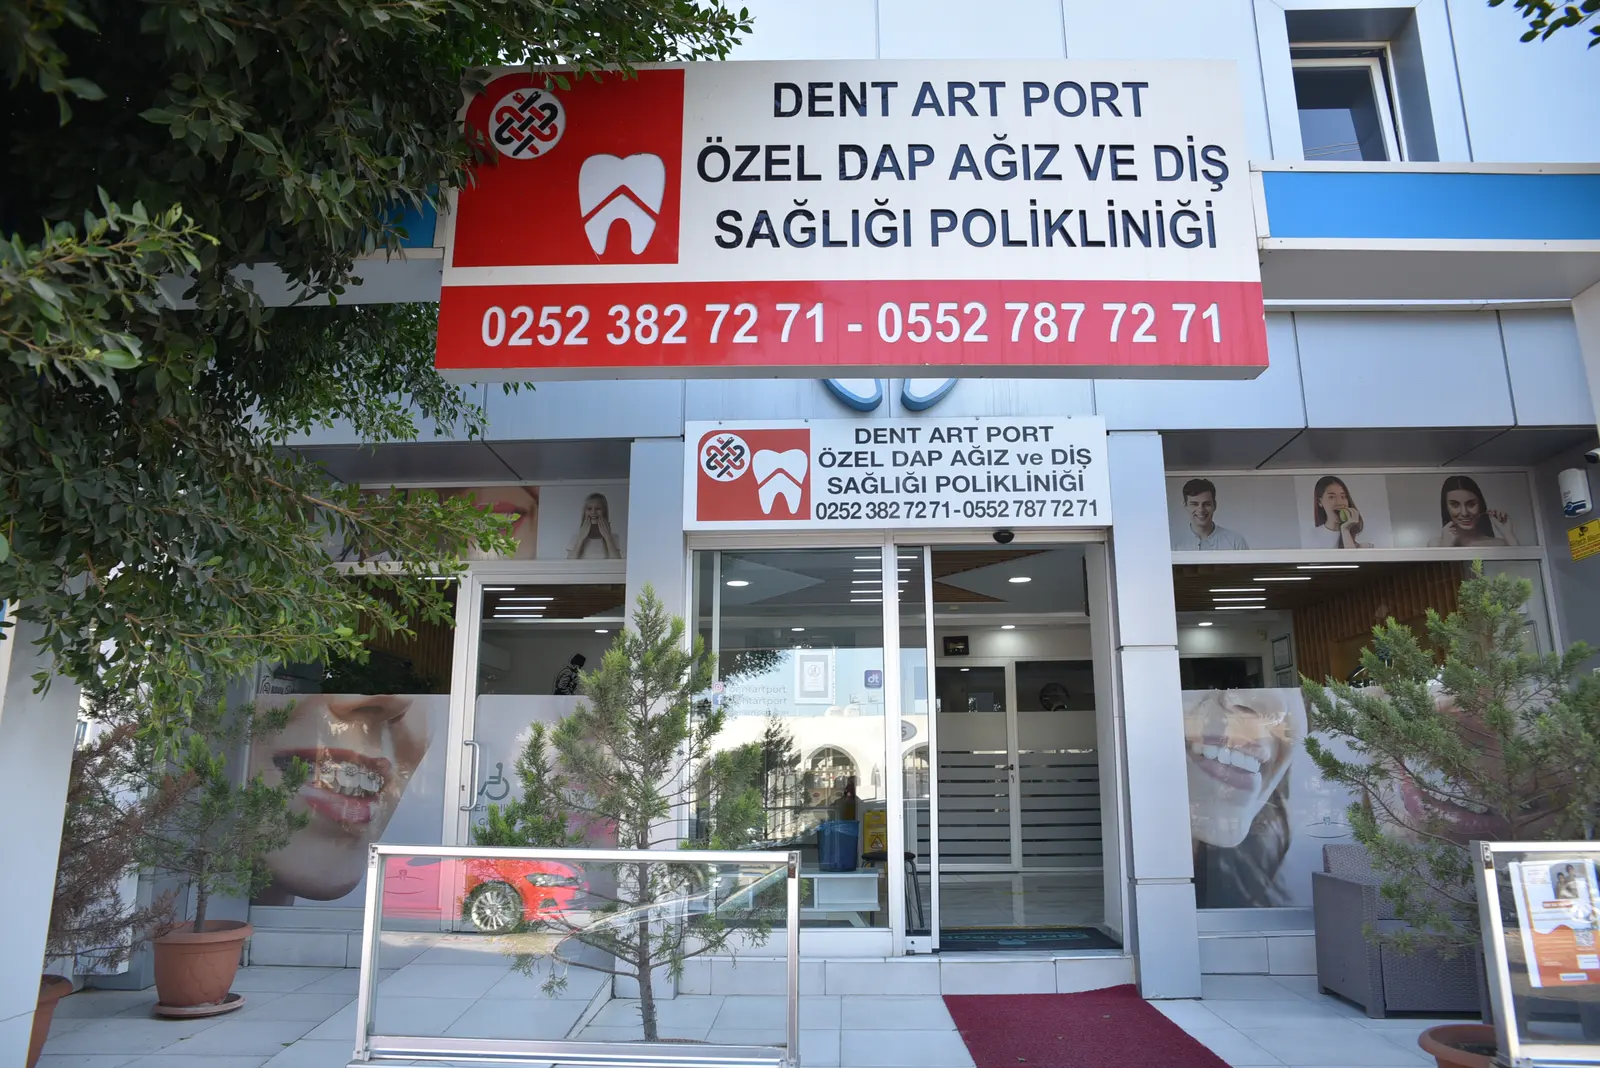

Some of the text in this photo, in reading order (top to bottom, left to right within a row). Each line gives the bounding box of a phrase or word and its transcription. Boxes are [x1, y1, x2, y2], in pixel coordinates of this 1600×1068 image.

[773, 80, 1149, 118] DENT ART PORT
[696, 133, 1229, 193] ÖZEL DAP AĞIZ VE DİŞ
[714, 198, 1217, 250] SAĞLIĞI POLİKLİNİĞİ
[481, 305, 589, 348] 0252
[606, 303, 688, 345] 382
[705, 302, 758, 344] 72
[775, 302, 824, 344] 71
[877, 301, 989, 343] 0552
[1004, 301, 1086, 343] 787
[1102, 302, 1157, 343] 72
[1171, 302, 1221, 343] 71
[854, 425, 1054, 445] DENT ART PORT
[818, 444, 1092, 470] ÖZEL DAP AĞIZ ve DİŞ
[827, 469, 1084, 495] SAĞLIĞI POLİKLİNİĞİ
[815, 501, 862, 520] 0252
[865, 501, 901, 520] 382
[903, 500, 927, 519] 72
[929, 500, 950, 519] 71
[962, 500, 1010, 519] 0552
[1012, 499, 1047, 518] 787
[1050, 499, 1074, 517] 72
[1076, 499, 1097, 517] 71
